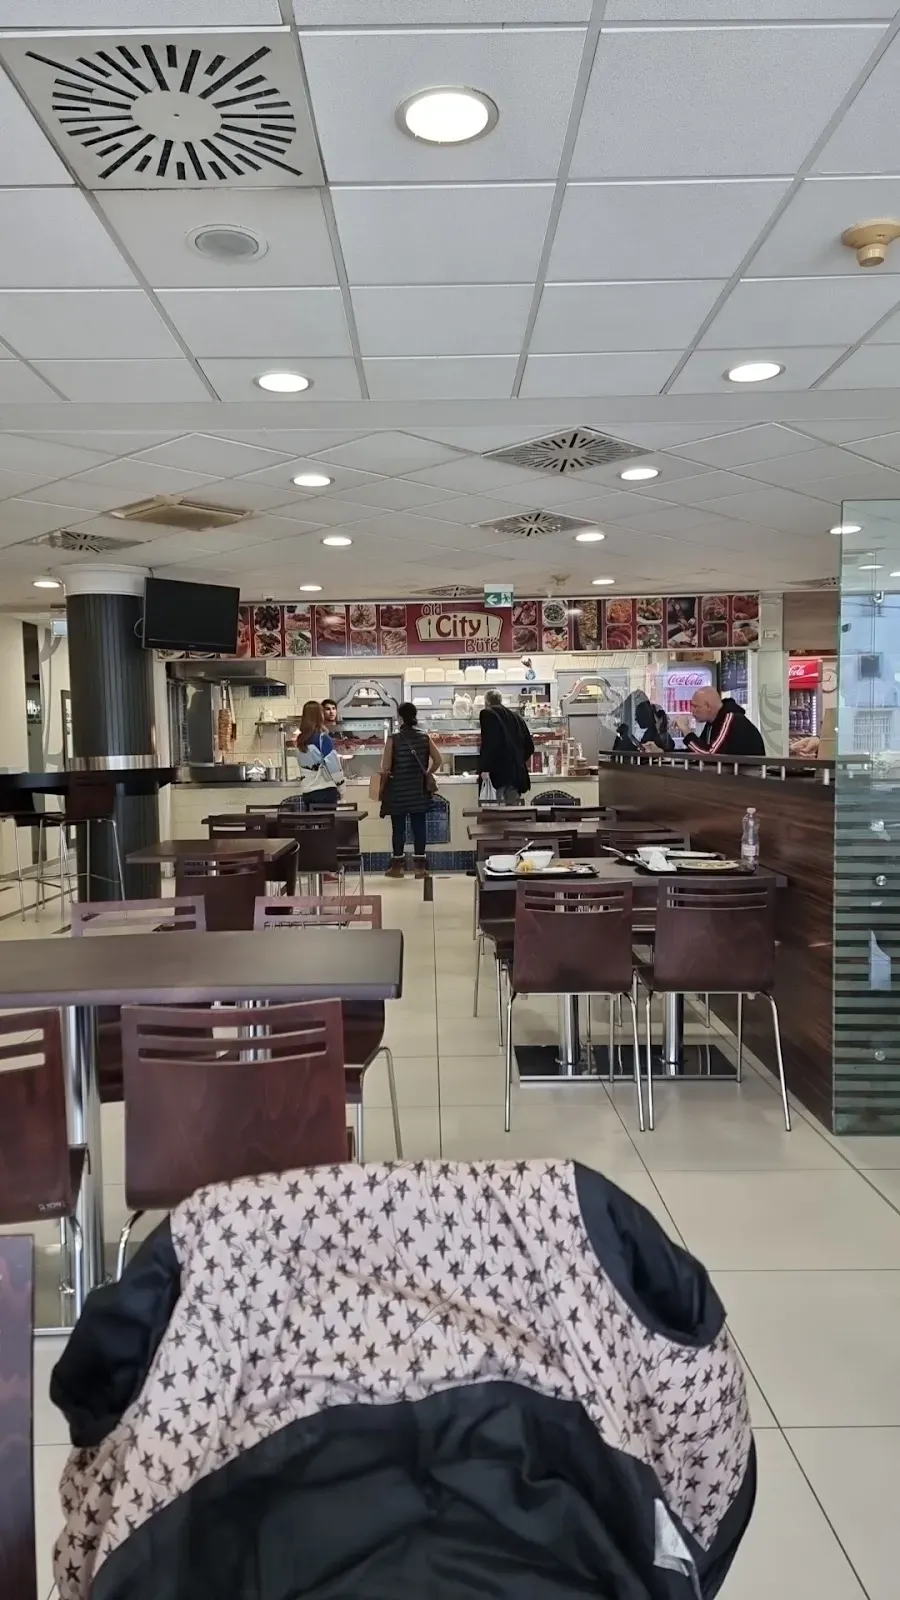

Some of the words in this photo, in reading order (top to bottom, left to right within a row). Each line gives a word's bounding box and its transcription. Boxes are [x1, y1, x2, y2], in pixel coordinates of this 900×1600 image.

[421, 603, 442, 616] Old
[435, 614, 481, 637] City
[465, 637, 499, 653] Büfé
